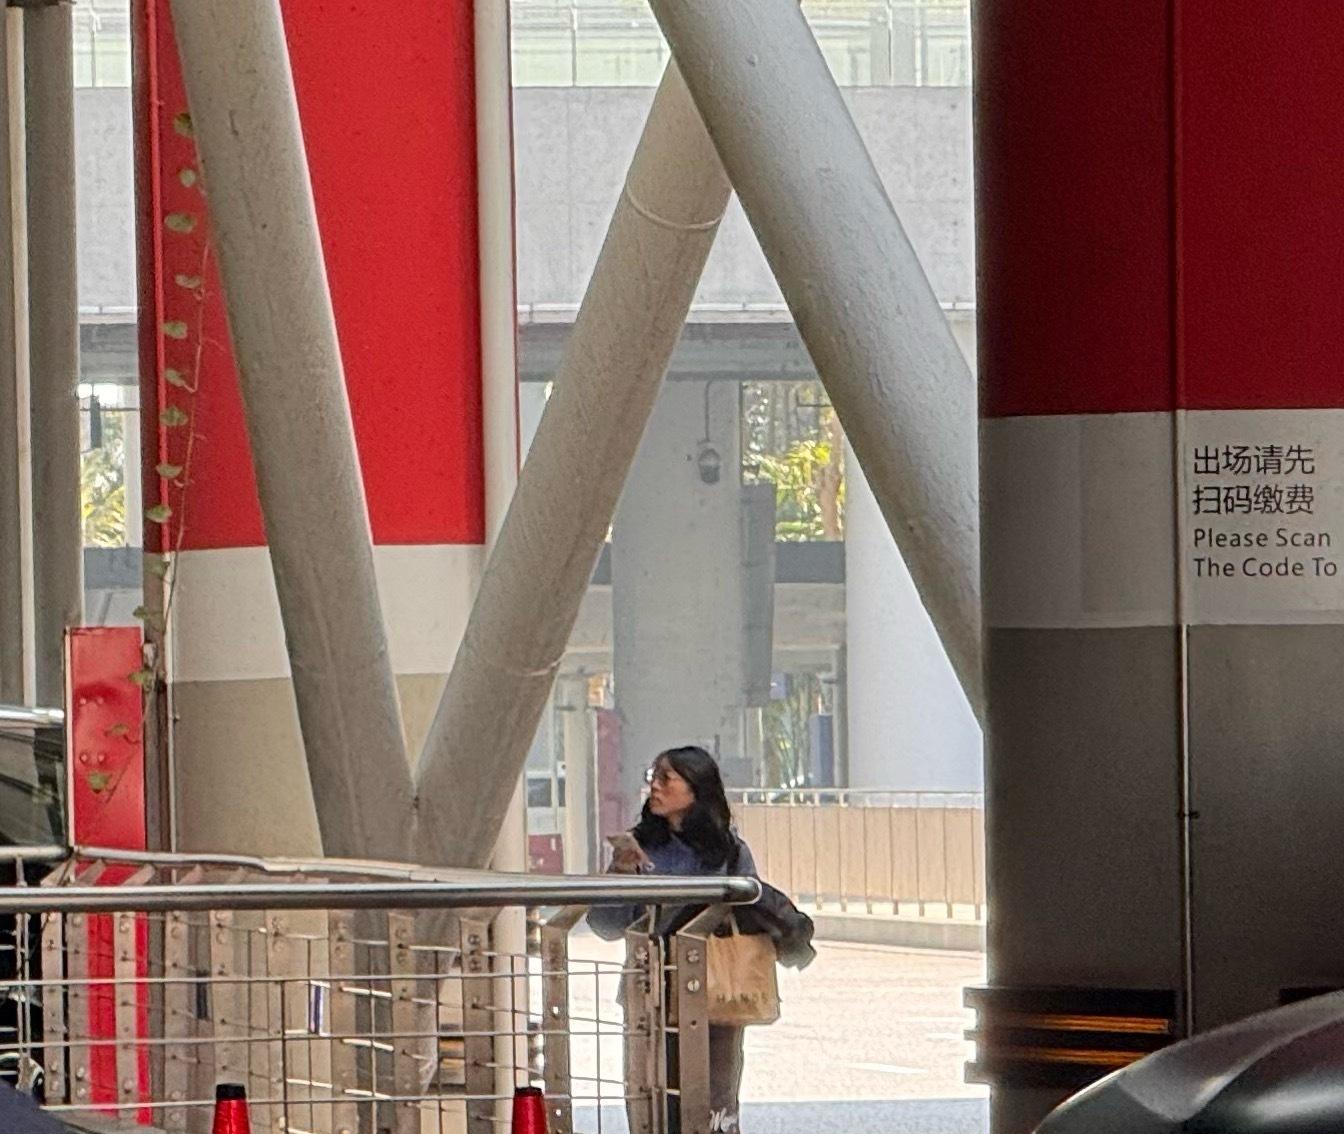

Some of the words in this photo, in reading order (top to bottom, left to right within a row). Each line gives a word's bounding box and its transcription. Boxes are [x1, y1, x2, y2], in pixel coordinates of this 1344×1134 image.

[1193, 445, 1315, 476] 出场请先
[1193, 484, 1315, 516] 扫码缴费
[1193, 527, 1268, 549] Please
[1275, 527, 1332, 549] Scan
[1193, 556, 1236, 578] The
[1242, 556, 1304, 578] Code
[1312, 556, 1339, 578] To
